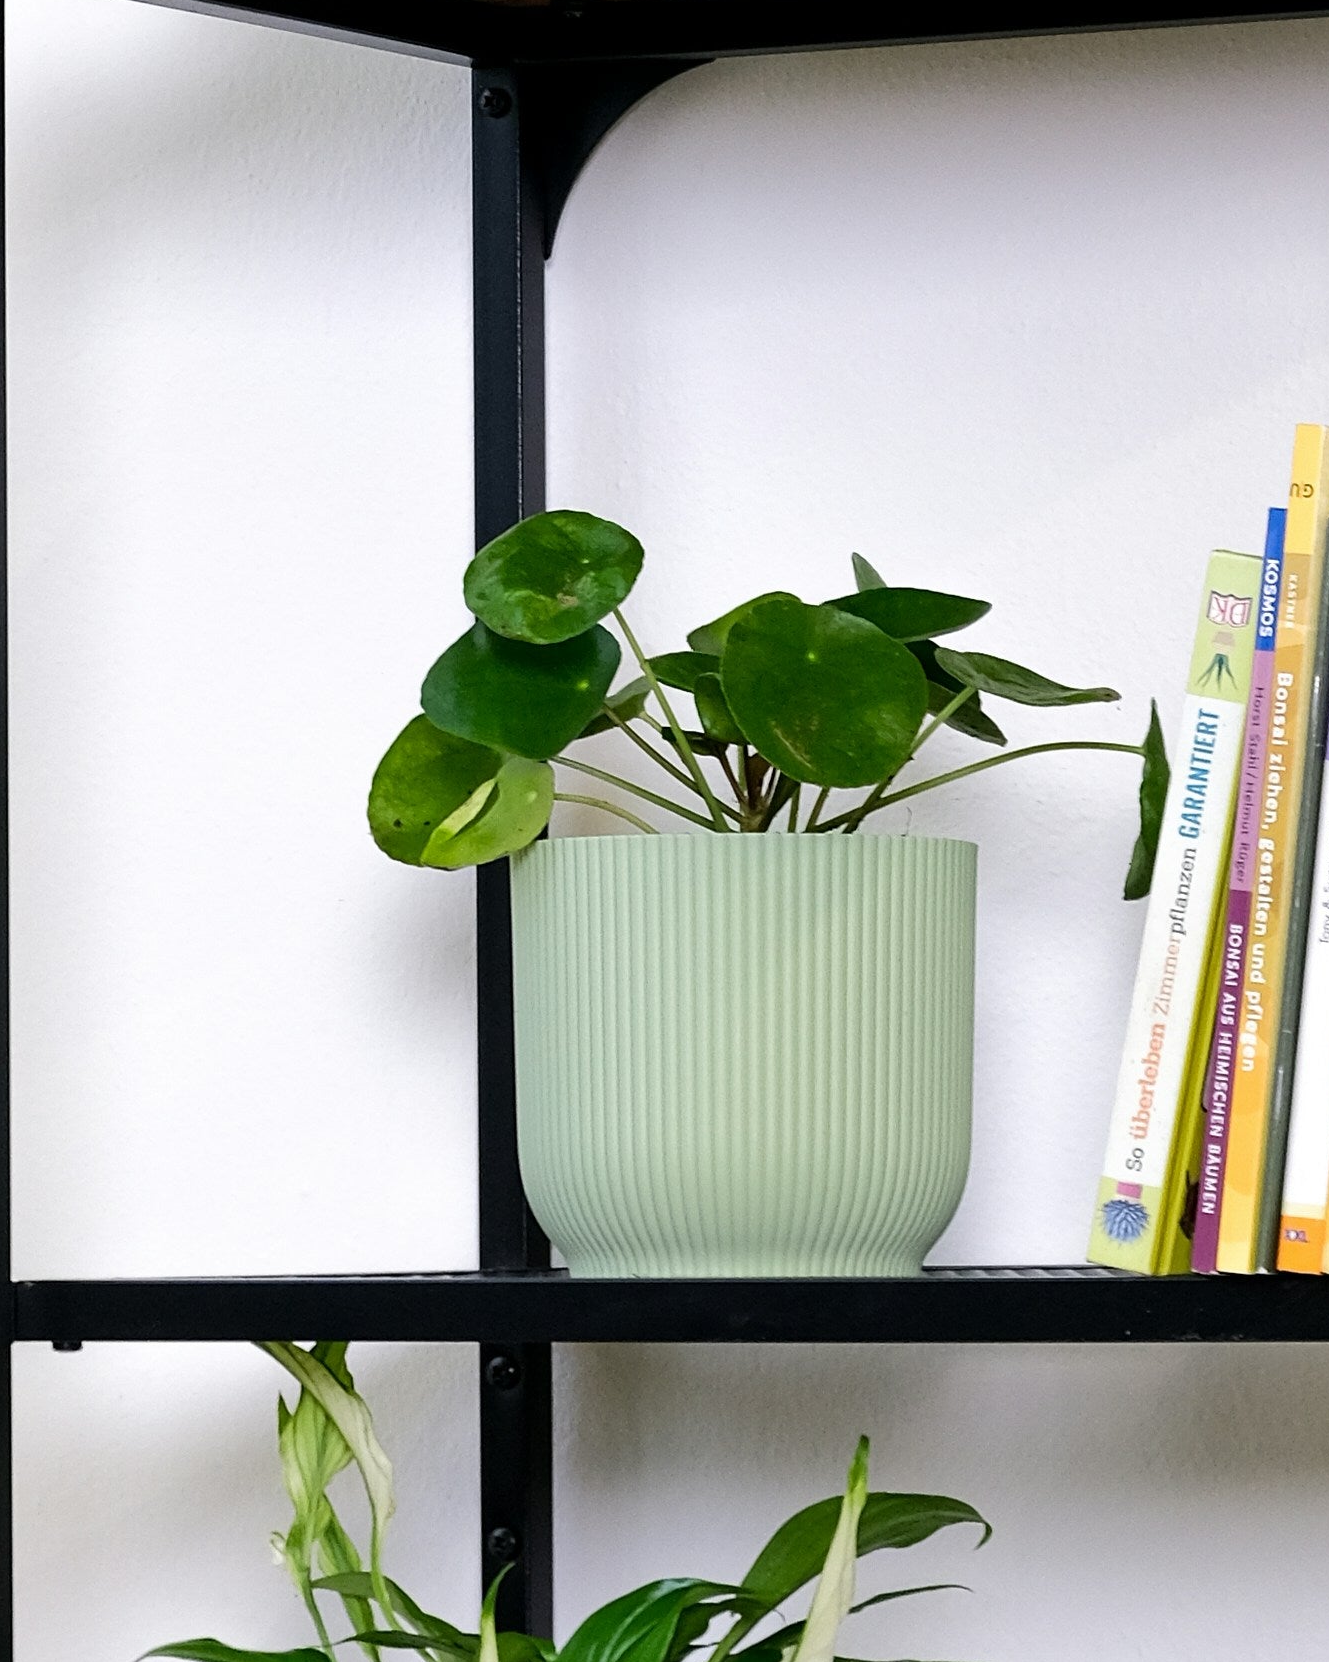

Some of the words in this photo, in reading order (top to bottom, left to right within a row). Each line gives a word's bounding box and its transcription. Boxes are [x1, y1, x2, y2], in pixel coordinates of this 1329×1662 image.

[1208, 592, 1252, 628] DK
[1259, 559, 1280, 638] KOSMOS
[1284, 574, 1298, 629] KASTNER
[1251, 687, 1264, 726] Horst
[1271, 672, 1294, 745] Bonsai
[1179, 708, 1220, 839] GARANTIERT
[1262, 754, 1285, 830] ziehen,
[1255, 839, 1275, 936] gestalten
[1224, 924, 1243, 986] BONSAI
[1250, 944, 1266, 984] und
[1220, 993, 1237, 1026] AUS
[1241, 991, 1263, 1072] pflegen
[1129, 1024, 1166, 1141] überleben
[1209, 1033, 1233, 1137] HEIMISCHEN
[1126, 1148, 1145, 1172] So
